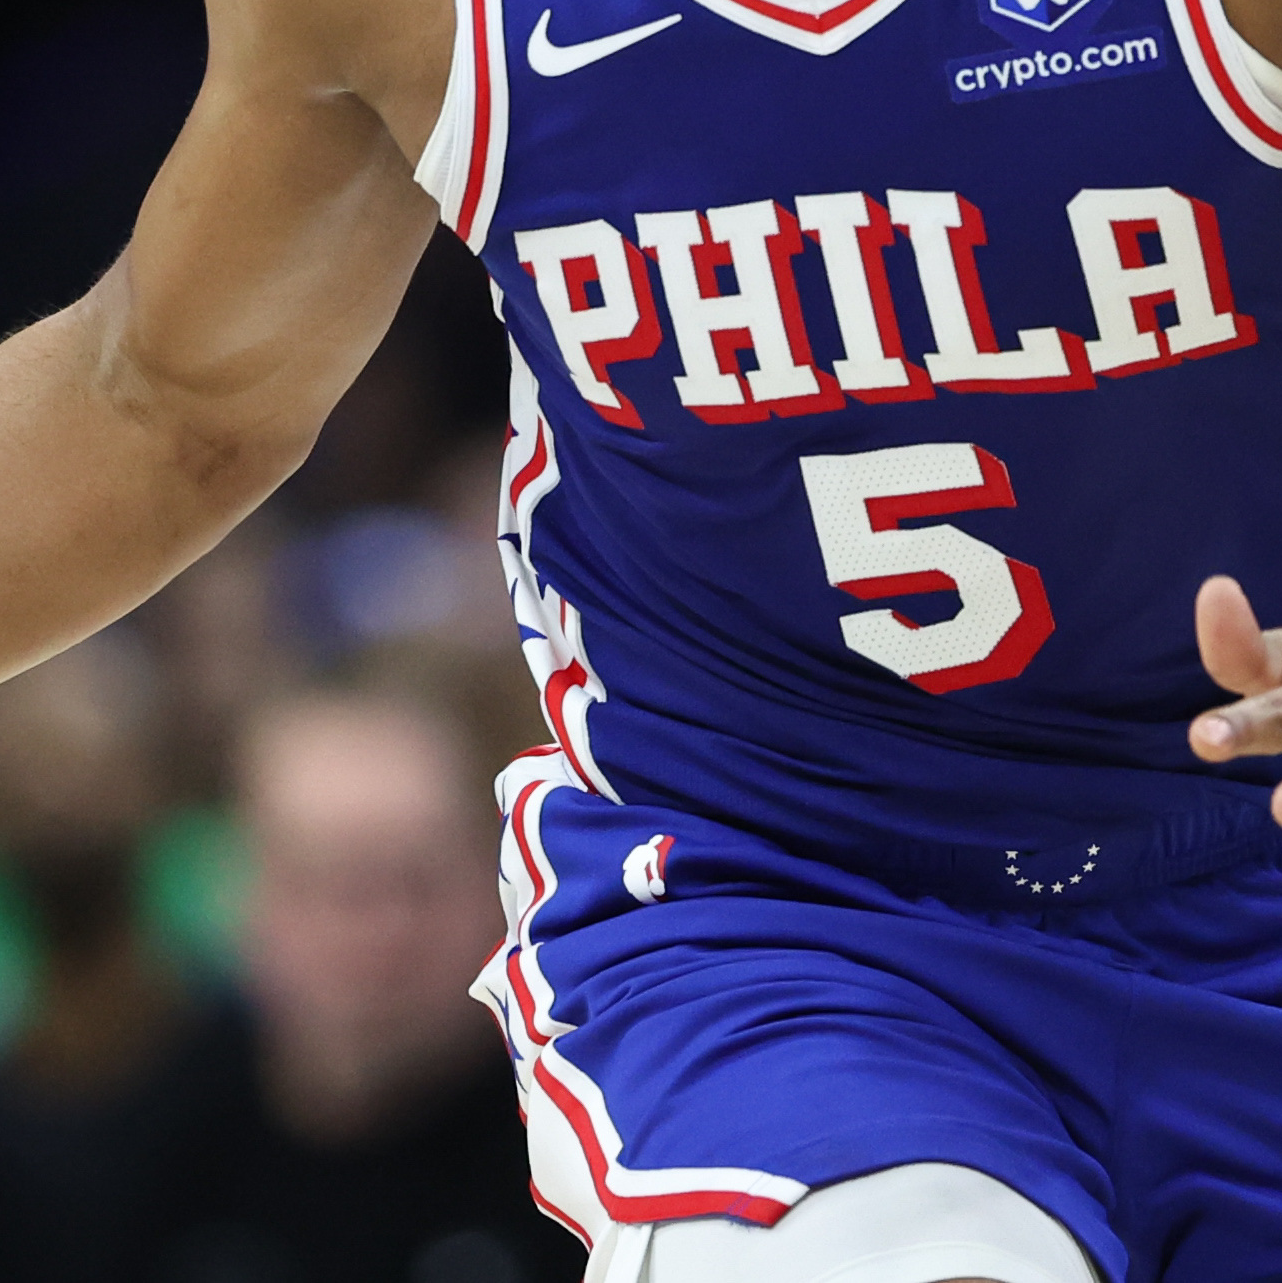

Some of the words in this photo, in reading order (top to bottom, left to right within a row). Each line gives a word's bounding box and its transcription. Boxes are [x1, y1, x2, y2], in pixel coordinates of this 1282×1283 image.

[954, 36, 1159, 92] crypto.com
[513, 185, 1260, 430] PHILA
[798, 442, 1057, 696] 5
